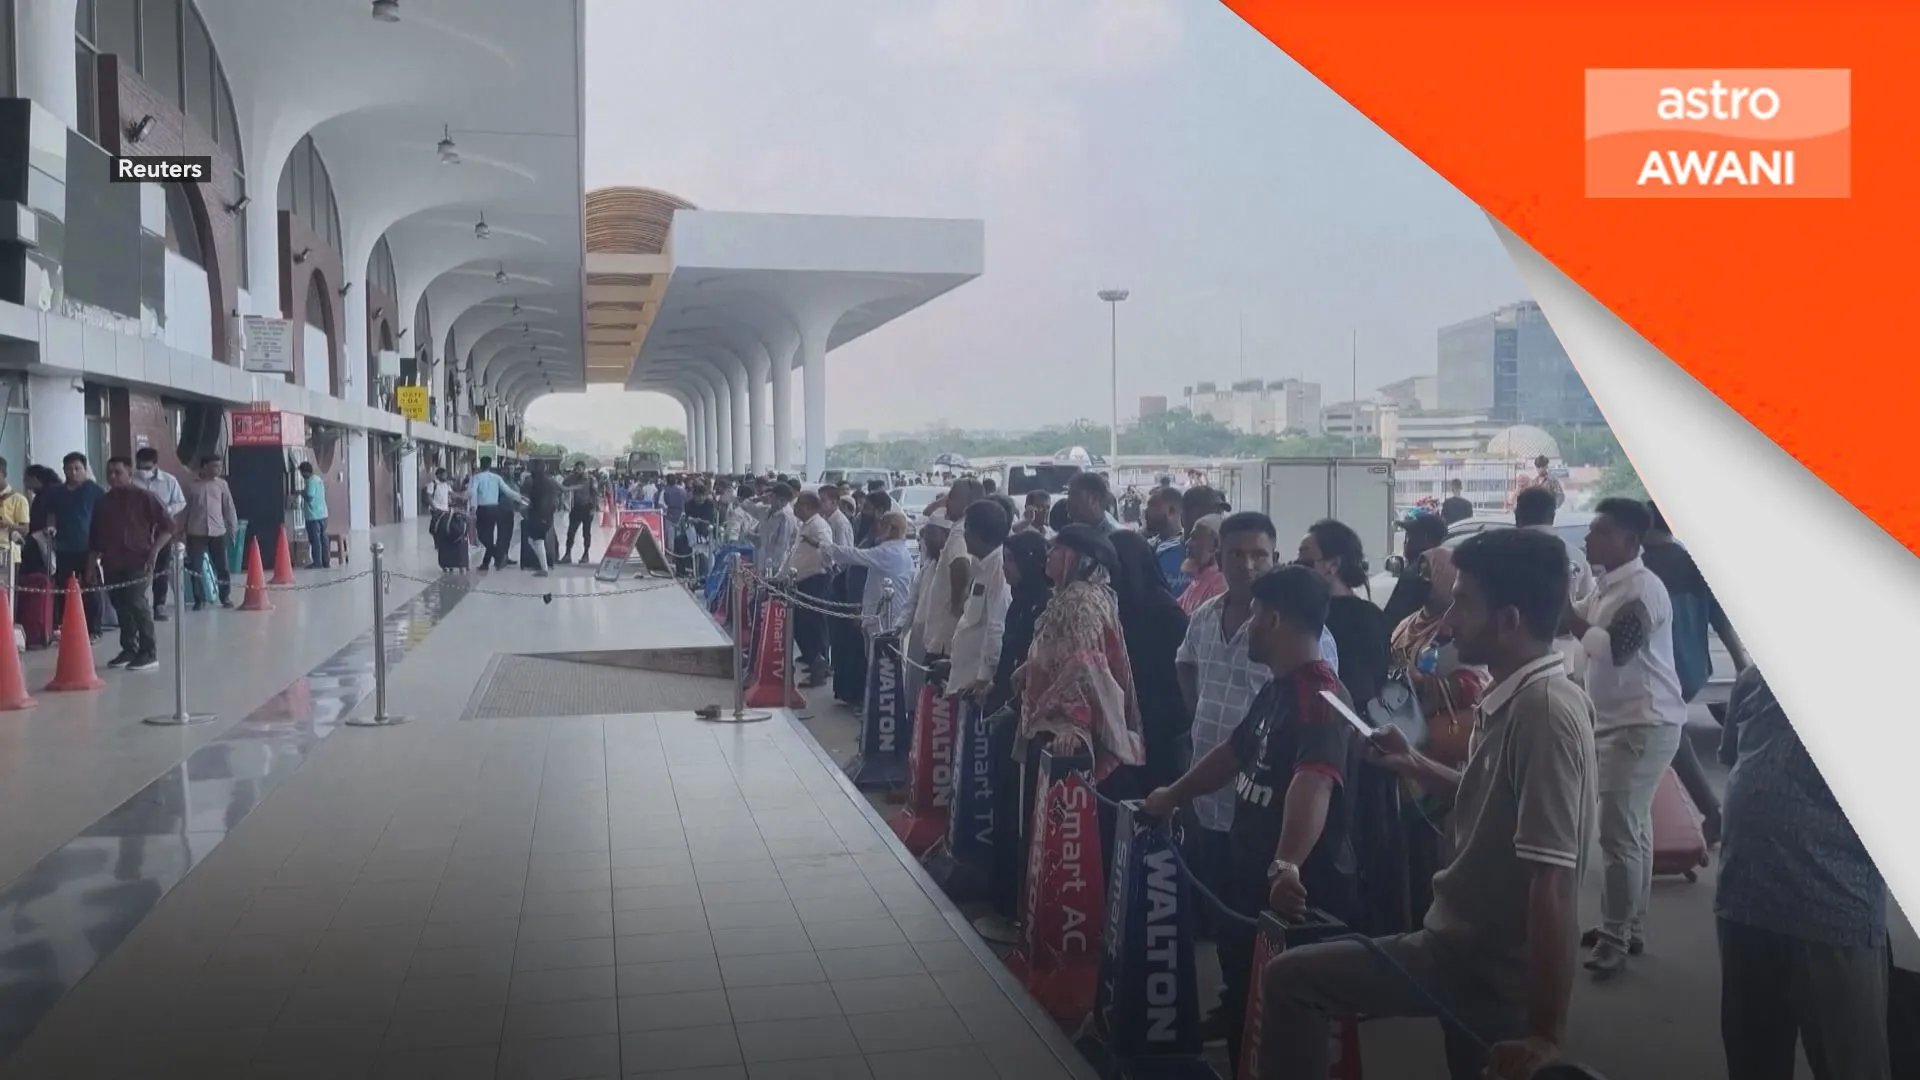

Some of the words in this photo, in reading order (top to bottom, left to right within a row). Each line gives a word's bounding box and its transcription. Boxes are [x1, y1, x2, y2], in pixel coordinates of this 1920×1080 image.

[772, 659, 785, 678] TV
[773, 606, 786, 652] Smart
[878, 657, 895, 752] WALTON
[931, 693, 953, 807] WALTON
[972, 719, 993, 800] Smart
[974, 808, 994, 846] TV
[1062, 786, 1088, 894] Smart
[1062, 905, 1087, 954] AC
[1106, 839, 1128, 962] Smart
[1144, 849, 1178, 1042] WALTON
